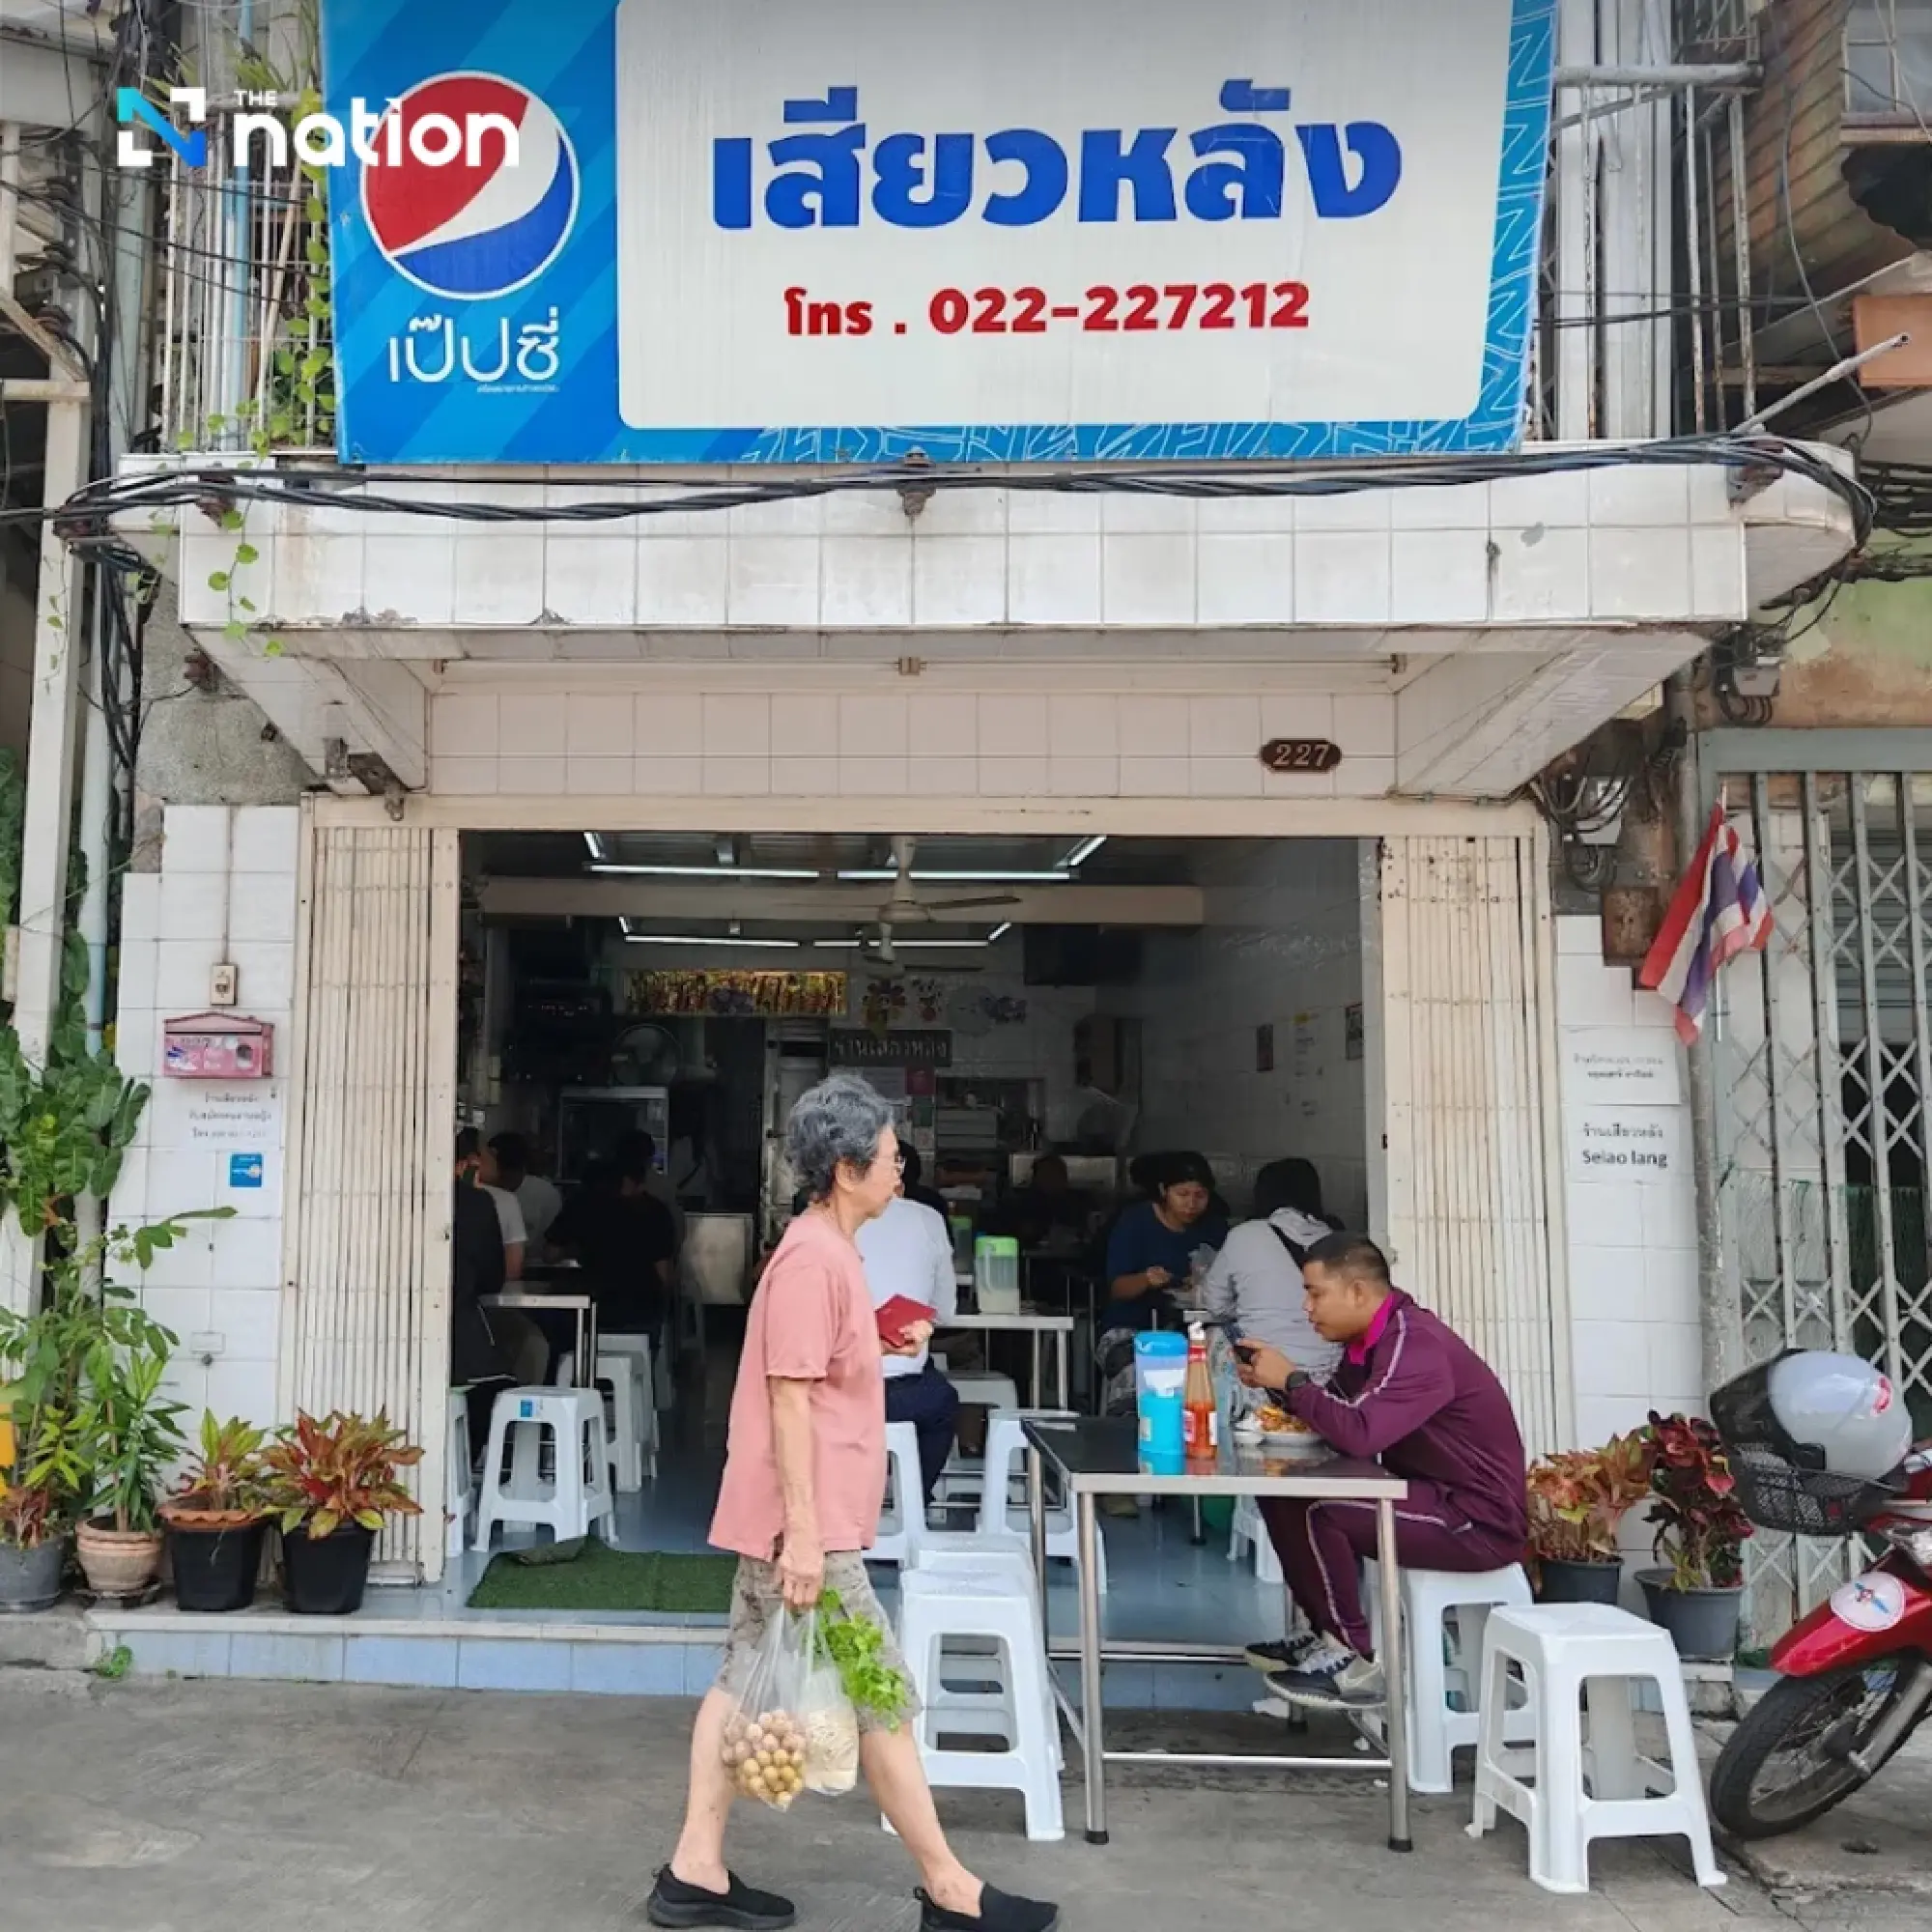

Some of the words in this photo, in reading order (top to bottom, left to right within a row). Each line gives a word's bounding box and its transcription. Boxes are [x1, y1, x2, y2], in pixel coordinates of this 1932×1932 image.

[713, 79, 1404, 230] เสียวหลัง
[783, 286, 873, 337] โทร
[928, 281, 1310, 334] 022-227212
[389, 305, 560, 383] เป๊ปซี่
[1272, 744, 1329, 767] 227
